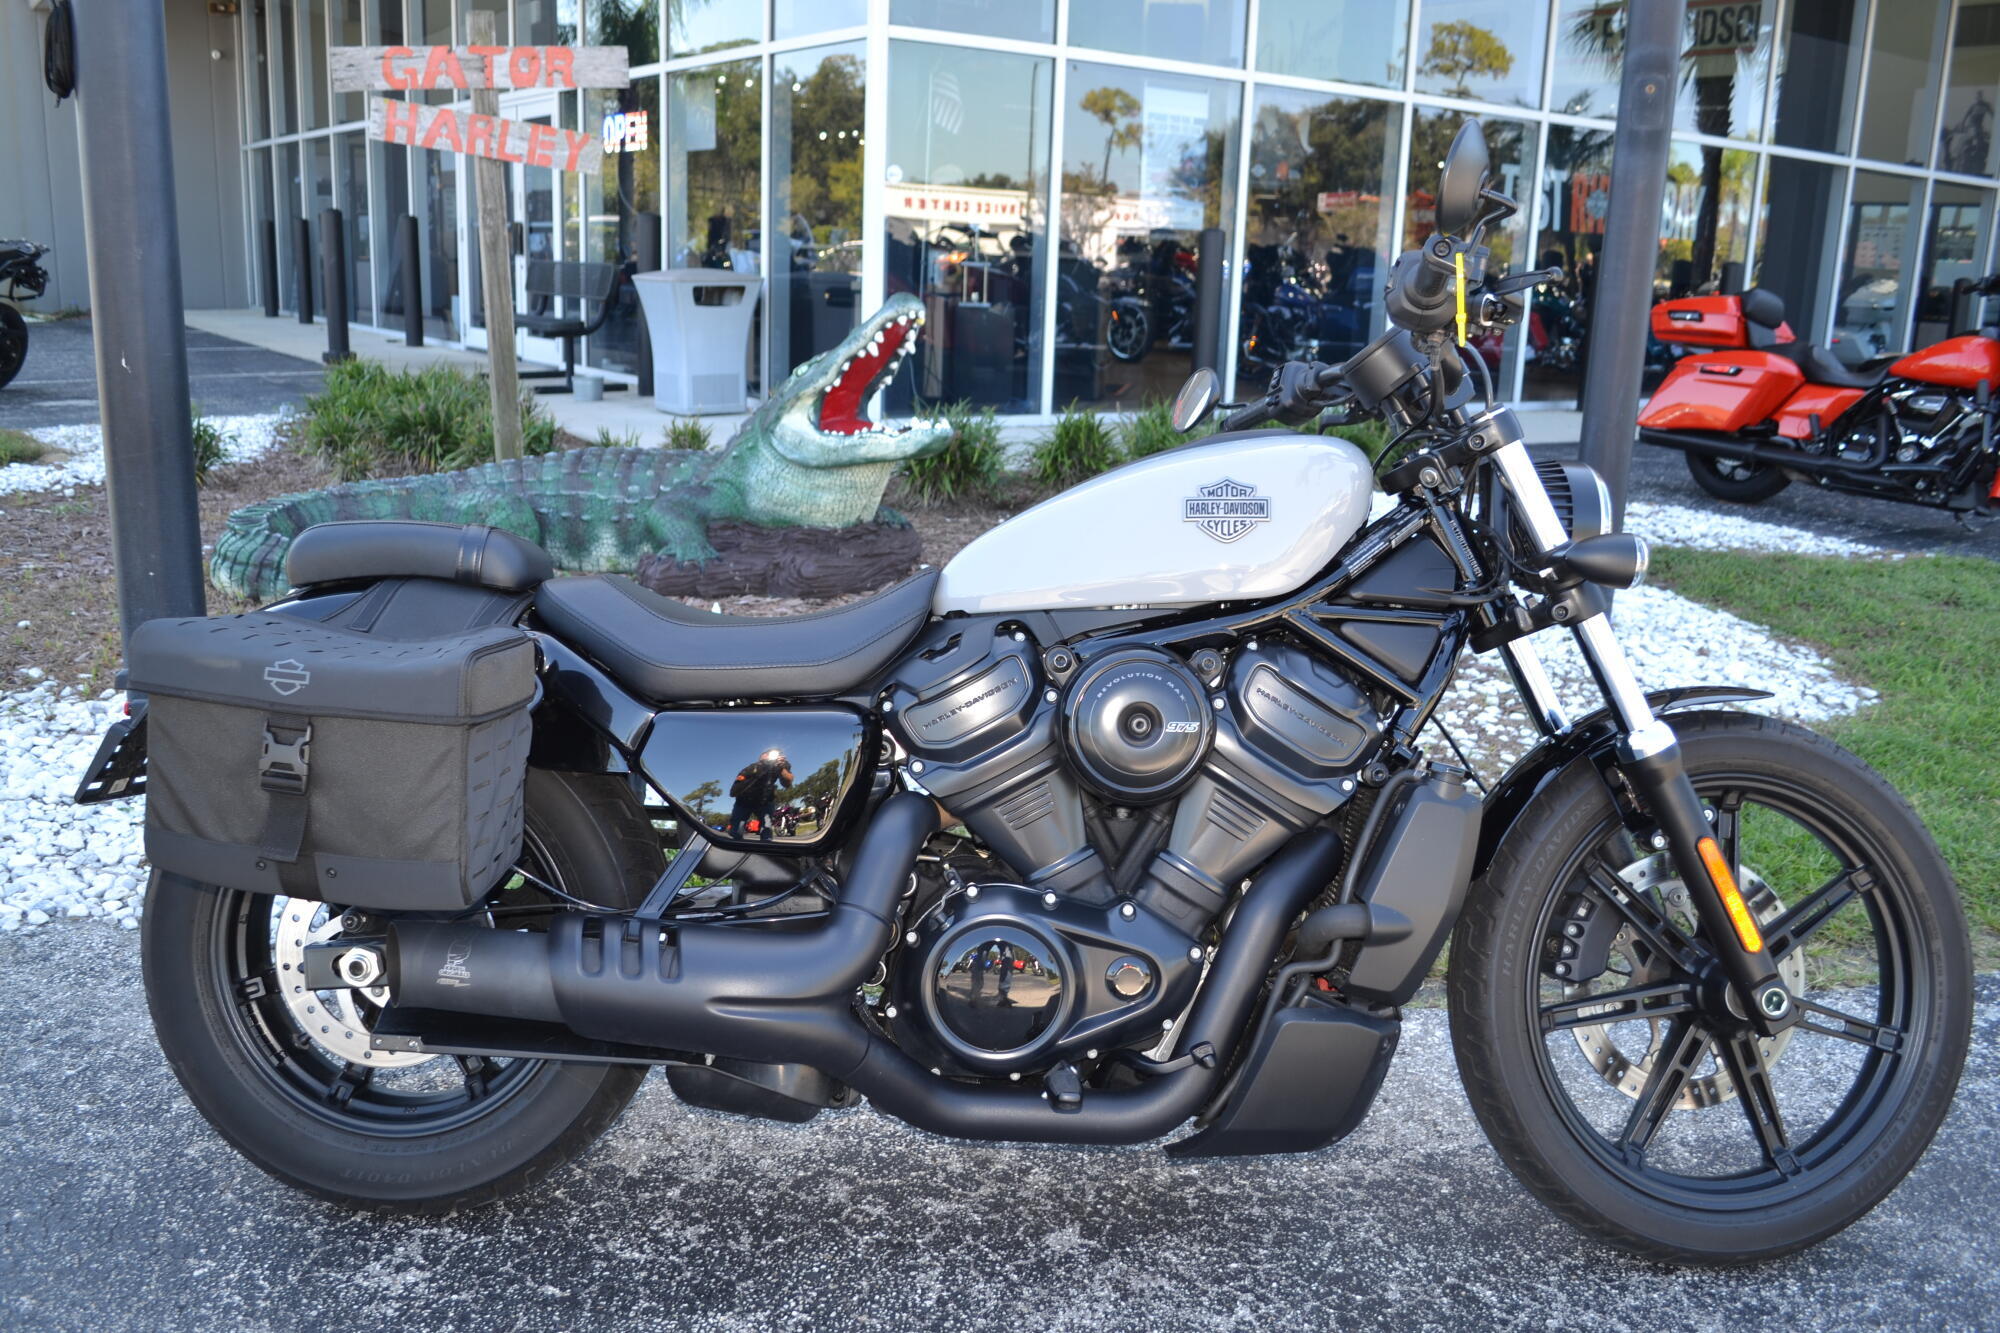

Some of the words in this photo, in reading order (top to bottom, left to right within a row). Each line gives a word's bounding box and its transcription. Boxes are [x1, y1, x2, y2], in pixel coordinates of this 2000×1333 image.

[382, 45, 577, 90] GATOR
[384, 99, 590, 172] HARLEY
[603, 111, 648, 153] OPEN
[1207, 483, 1247, 497] MOTOR
[1189, 502, 1265, 515] HARLEY-DAVIDSON
[1207, 520, 1247, 536] CYCLES
[1097, 672, 1162, 698] REVOLUTION
[922, 677, 1018, 730] HARLEY-DAVIDSON
[1165, 721, 1200, 733] 975
